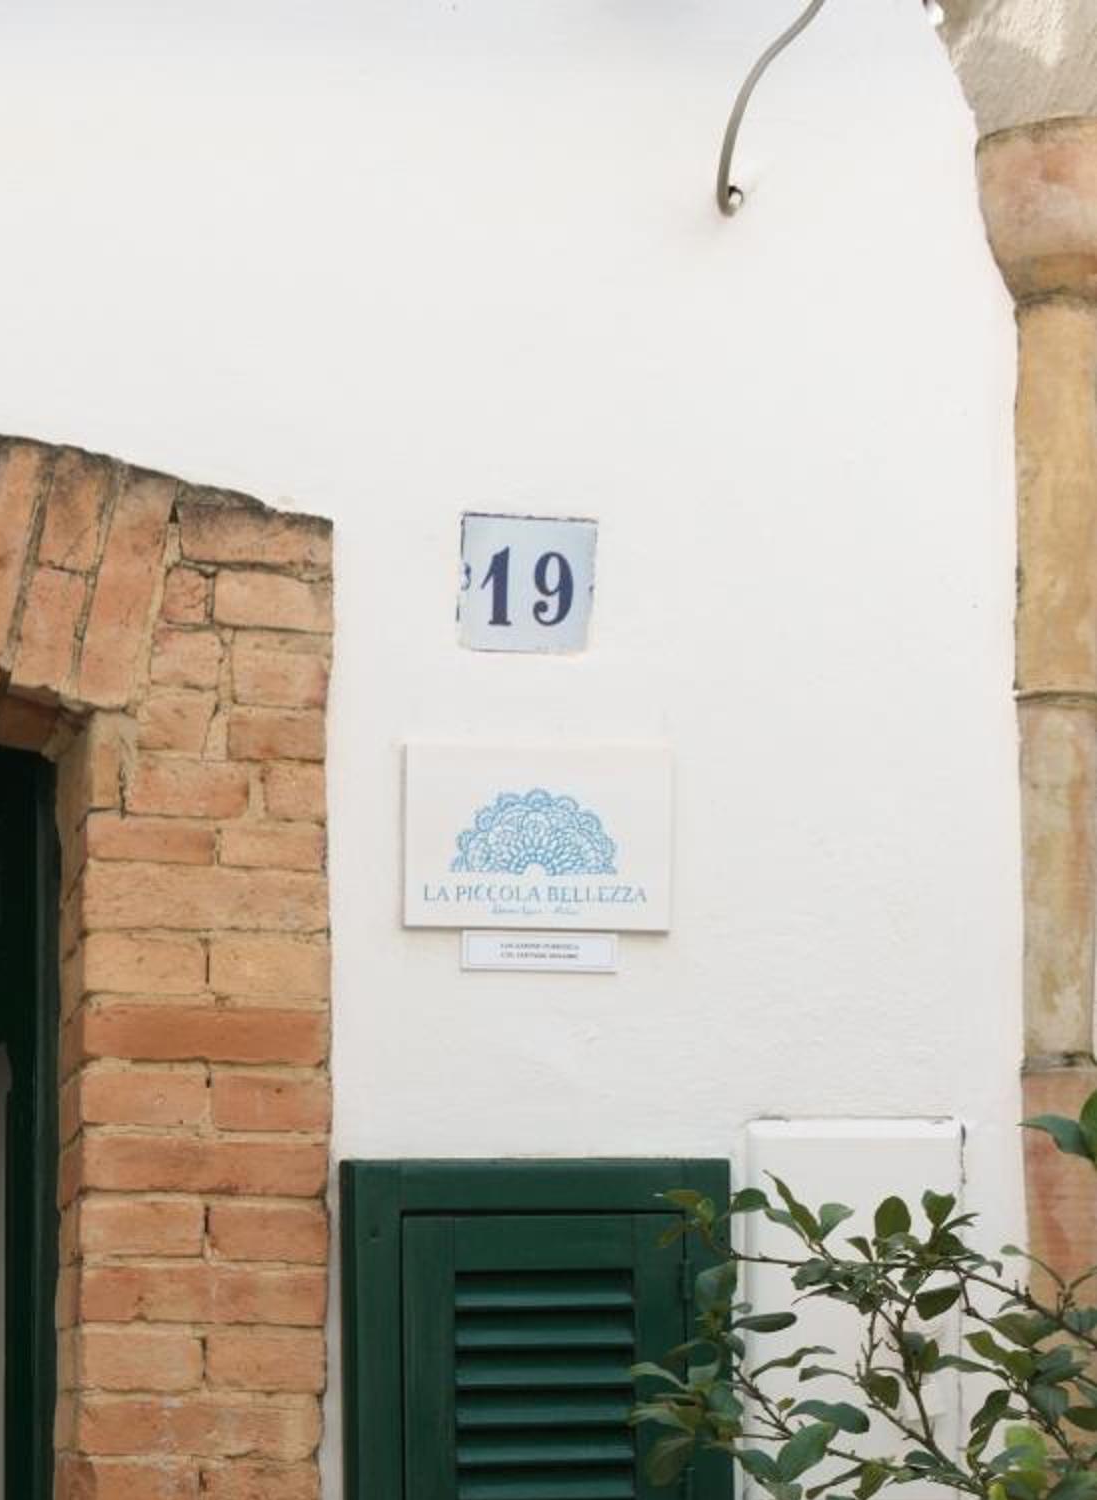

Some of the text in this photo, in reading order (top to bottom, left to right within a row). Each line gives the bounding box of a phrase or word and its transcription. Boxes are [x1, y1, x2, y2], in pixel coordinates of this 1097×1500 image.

[480, 545, 574, 627] 19
[422, 883, 647, 903] LA PICCOLA BELLEZZA
